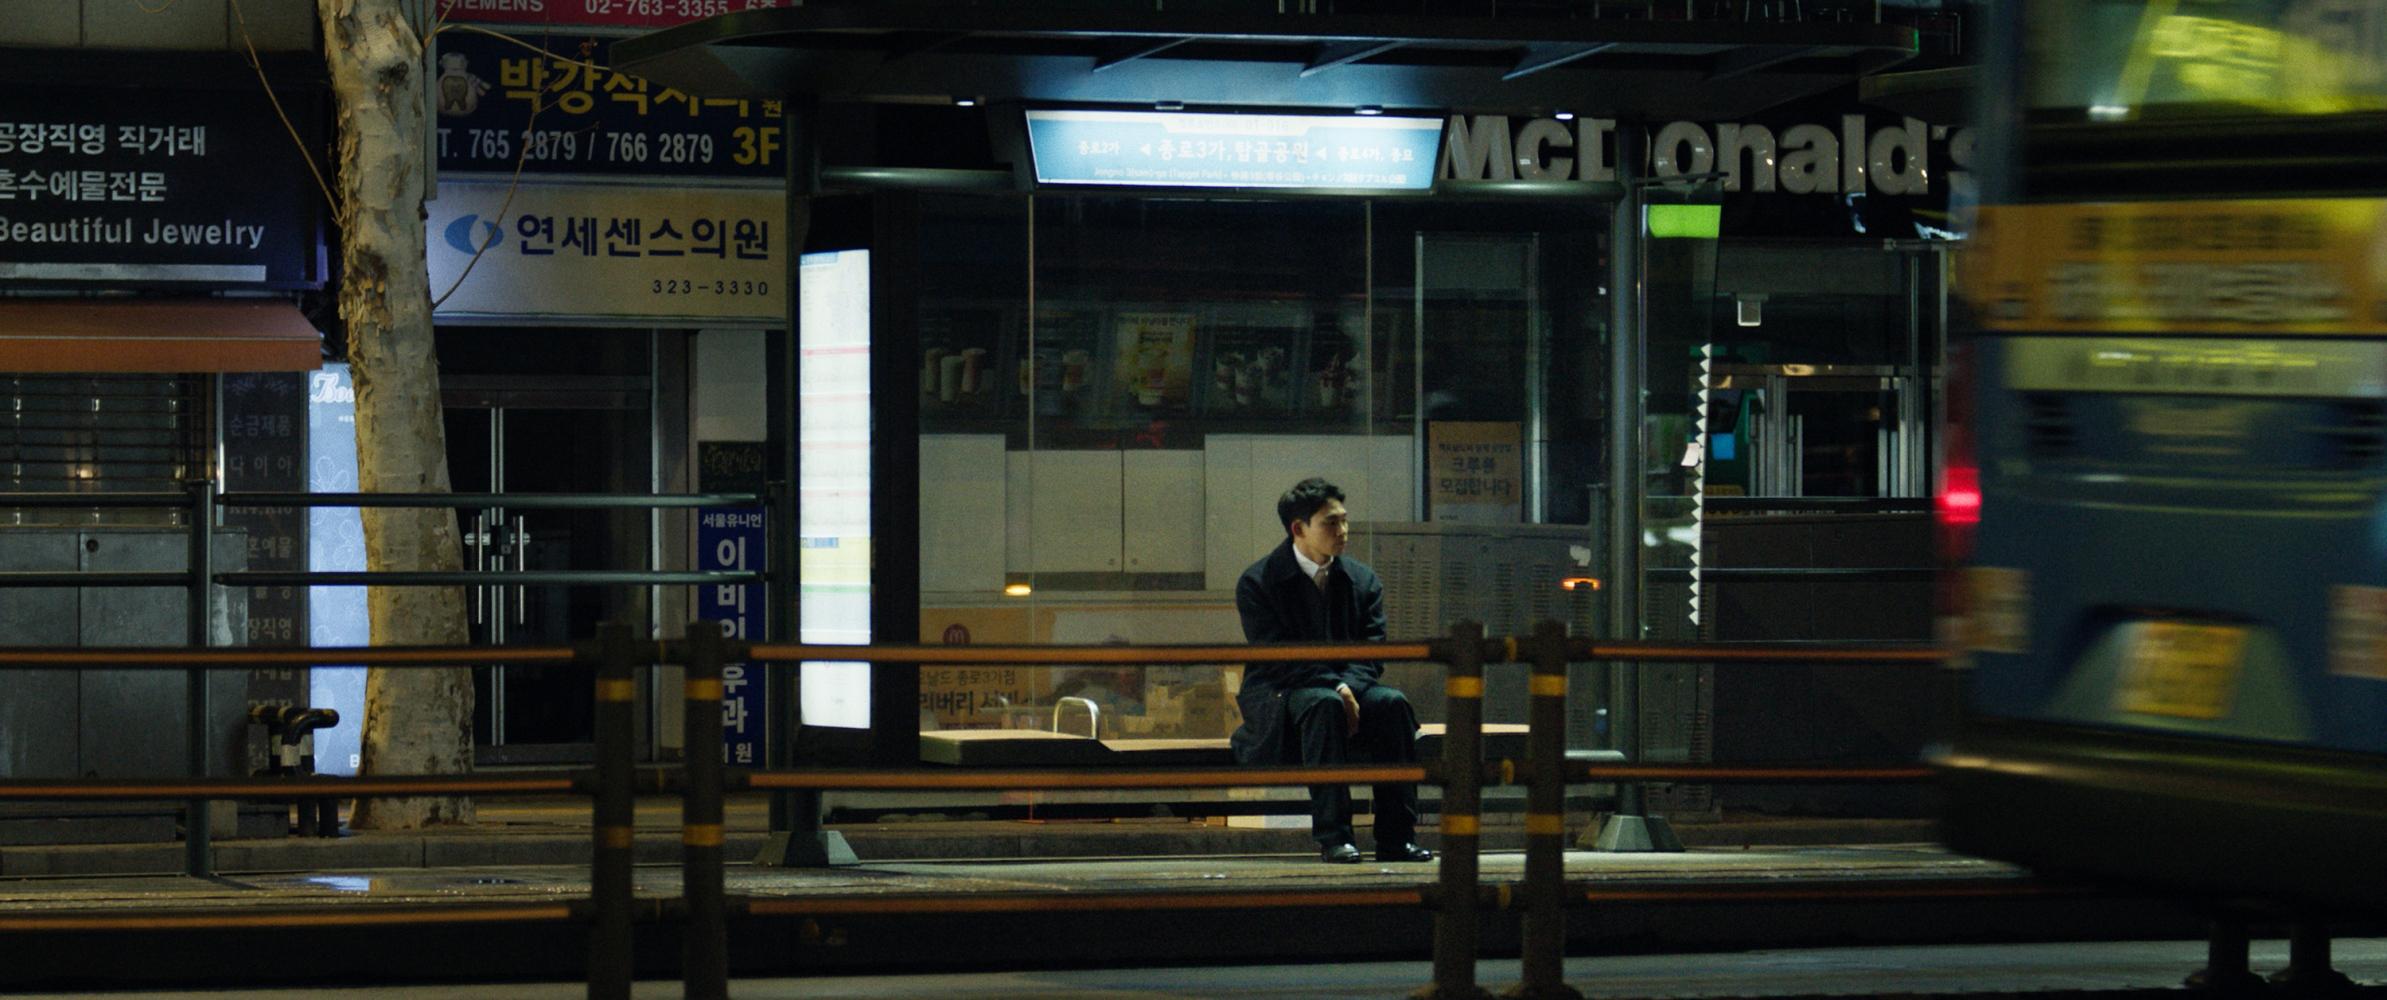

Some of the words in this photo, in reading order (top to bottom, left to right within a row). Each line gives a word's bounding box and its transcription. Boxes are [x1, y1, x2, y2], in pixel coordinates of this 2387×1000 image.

[584, 0, 729, 17] 02-763-3355
[118, 125, 206, 157] 직거래
[469, 129, 510, 159] 765
[521, 131, 577, 161] 2879
[607, 132, 648, 163] 766
[659, 133, 714, 164] 2879
[732, 126, 781, 165] 3F
[0, 169, 167, 202] 혼수예물전문
[0, 218, 132, 244] Beautiful
[143, 219, 264, 249] Jewelry
[517, 214, 769, 259] 연세센스의원
[652, 280, 769, 296] 323-3330
[231, 414, 292, 437] 순금제품
[1439, 478, 1512, 497] 모집합니다
[702, 513, 763, 528] 서울유니언
